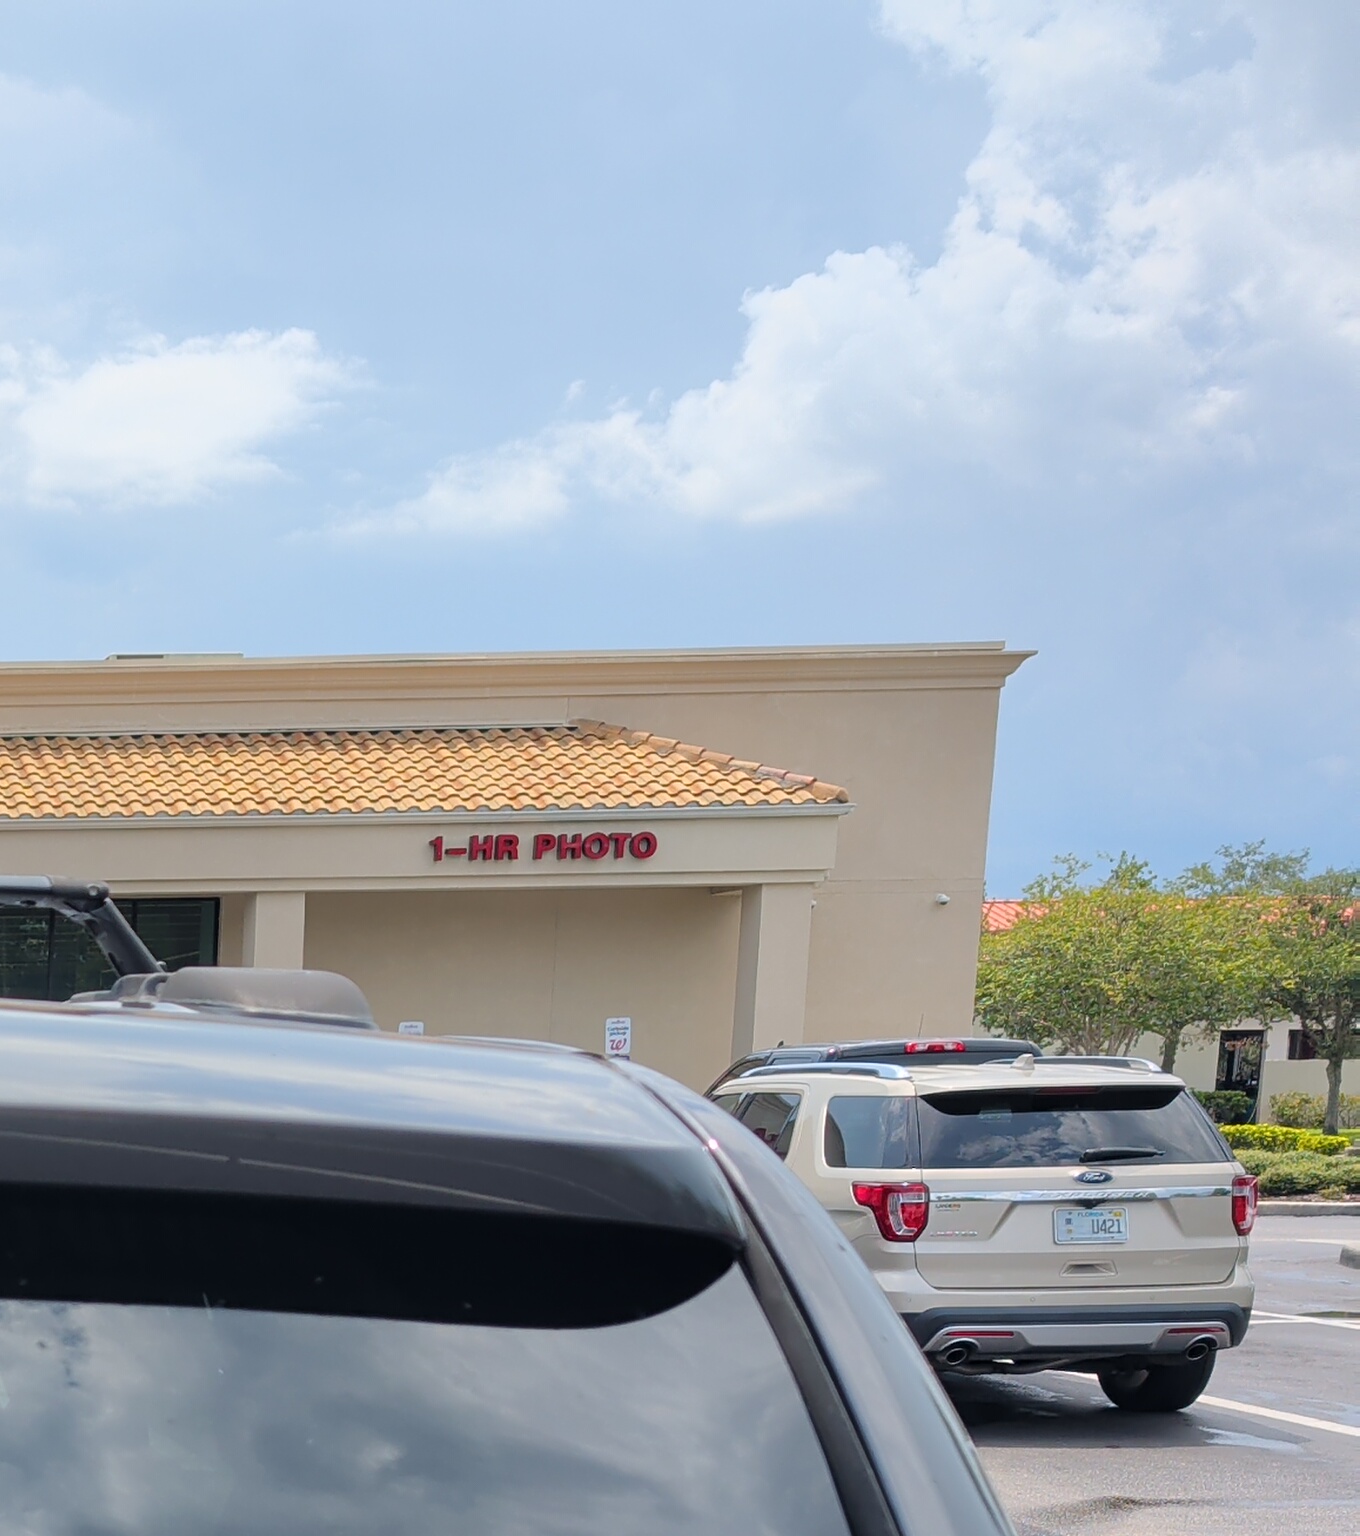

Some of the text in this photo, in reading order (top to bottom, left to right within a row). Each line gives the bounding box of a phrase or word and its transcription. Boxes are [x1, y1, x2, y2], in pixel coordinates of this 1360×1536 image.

[428, 831, 658, 862] 1-HR PHOTO
[1083, 1172, 1105, 1181] Ford
